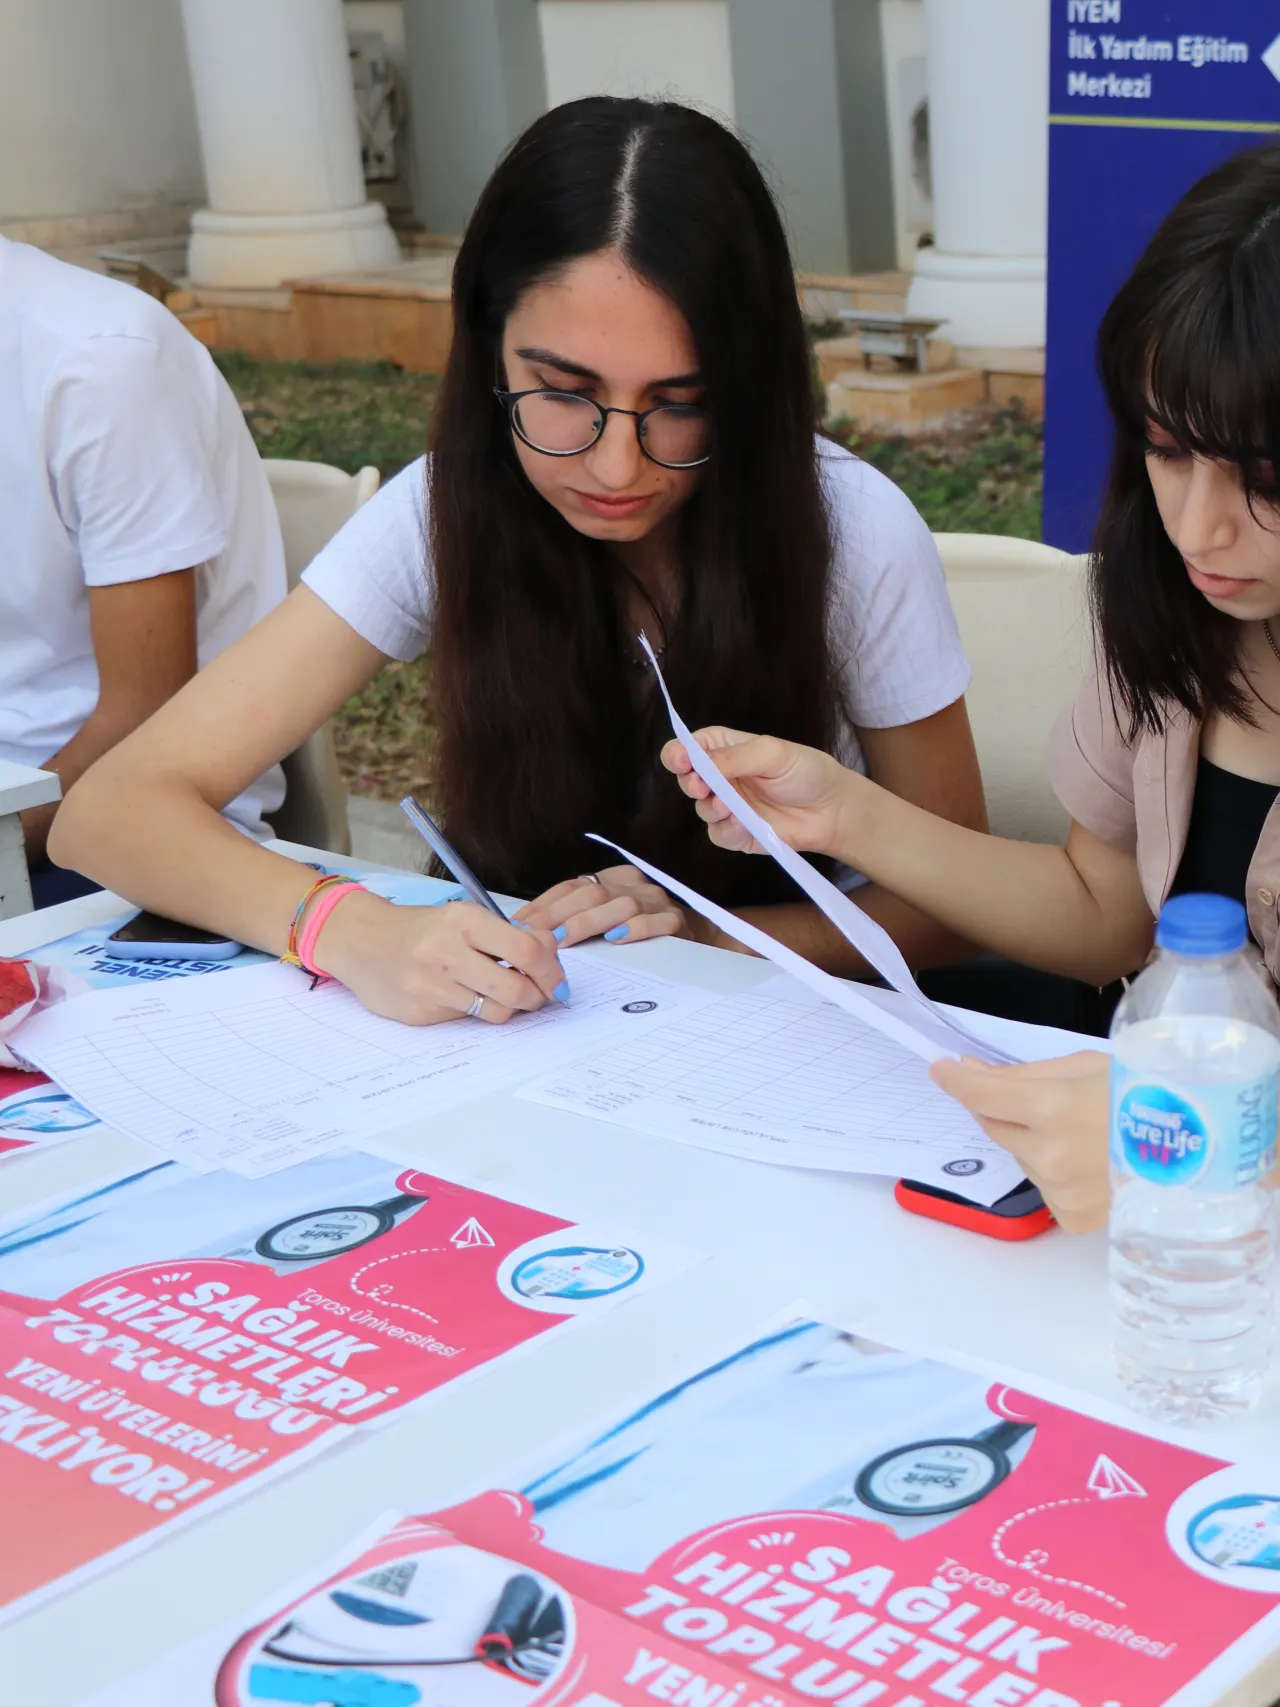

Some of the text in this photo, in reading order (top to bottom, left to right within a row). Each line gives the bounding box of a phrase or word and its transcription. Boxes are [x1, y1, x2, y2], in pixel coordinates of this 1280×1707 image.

[1067, 29, 1249, 68] İlk Yardım Eğitim
[1067, 71, 1152, 98] Merkezi
[80, 1286, 400, 1416] HİZMETLERİ
[178, 1282, 381, 1368] SAĞLIK
[297, 1287, 466, 1358] Toros Üniversitesi
[4, 1357, 269, 1473] YENİ ÜYELERİNİ
[790, 1546, 1072, 1674] SAĞLIK
[935, 1556, 1178, 1659] Toros Üniversitesi
